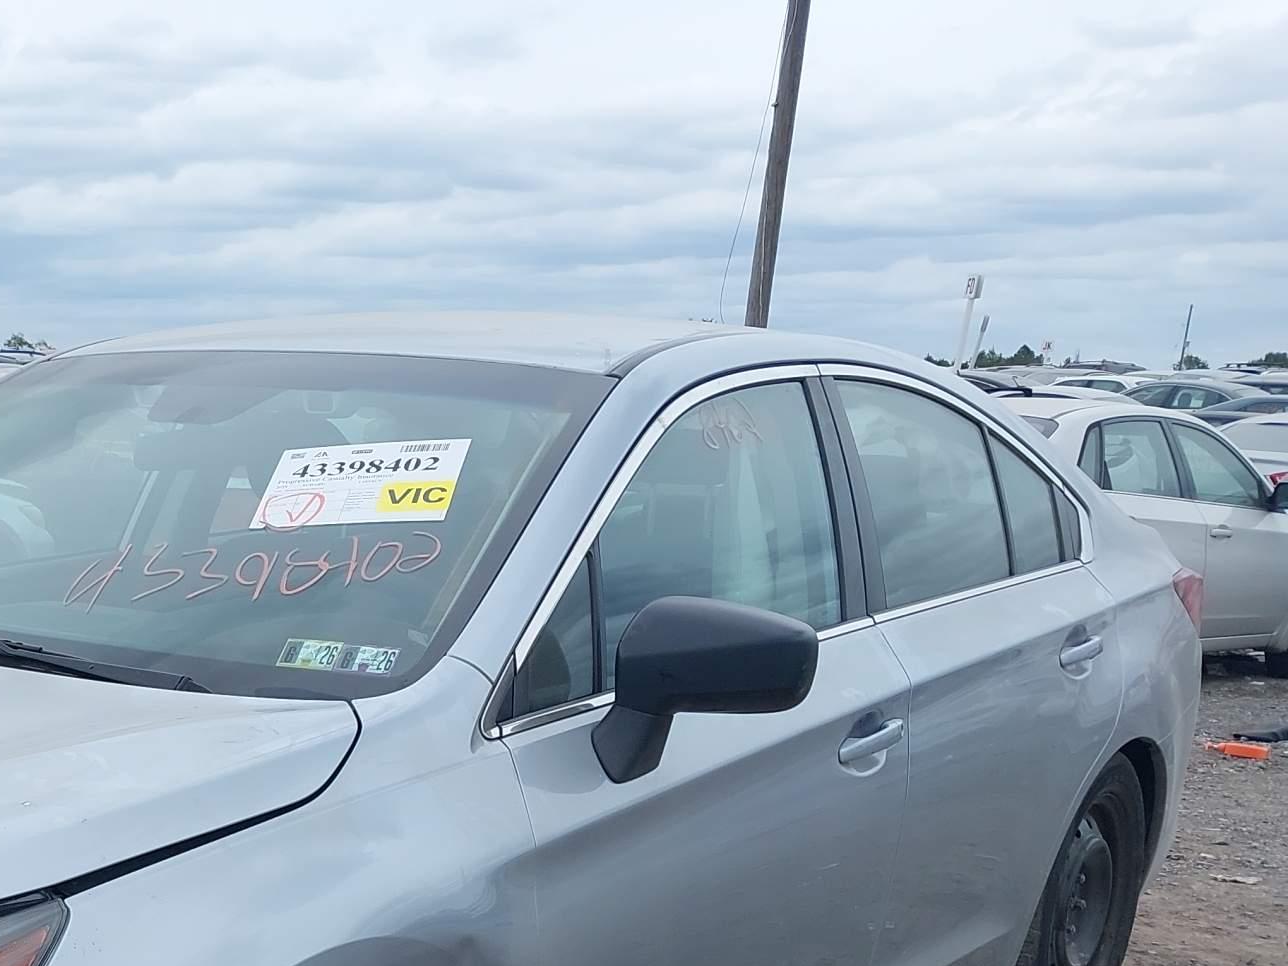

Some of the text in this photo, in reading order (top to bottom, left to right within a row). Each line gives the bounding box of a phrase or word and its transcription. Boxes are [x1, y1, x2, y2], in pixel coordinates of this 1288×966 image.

[292, 456, 441, 478] 43398402
[388, 487, 448, 505] VIC
[319, 645, 339, 666] 26
[377, 650, 396, 671] 26
